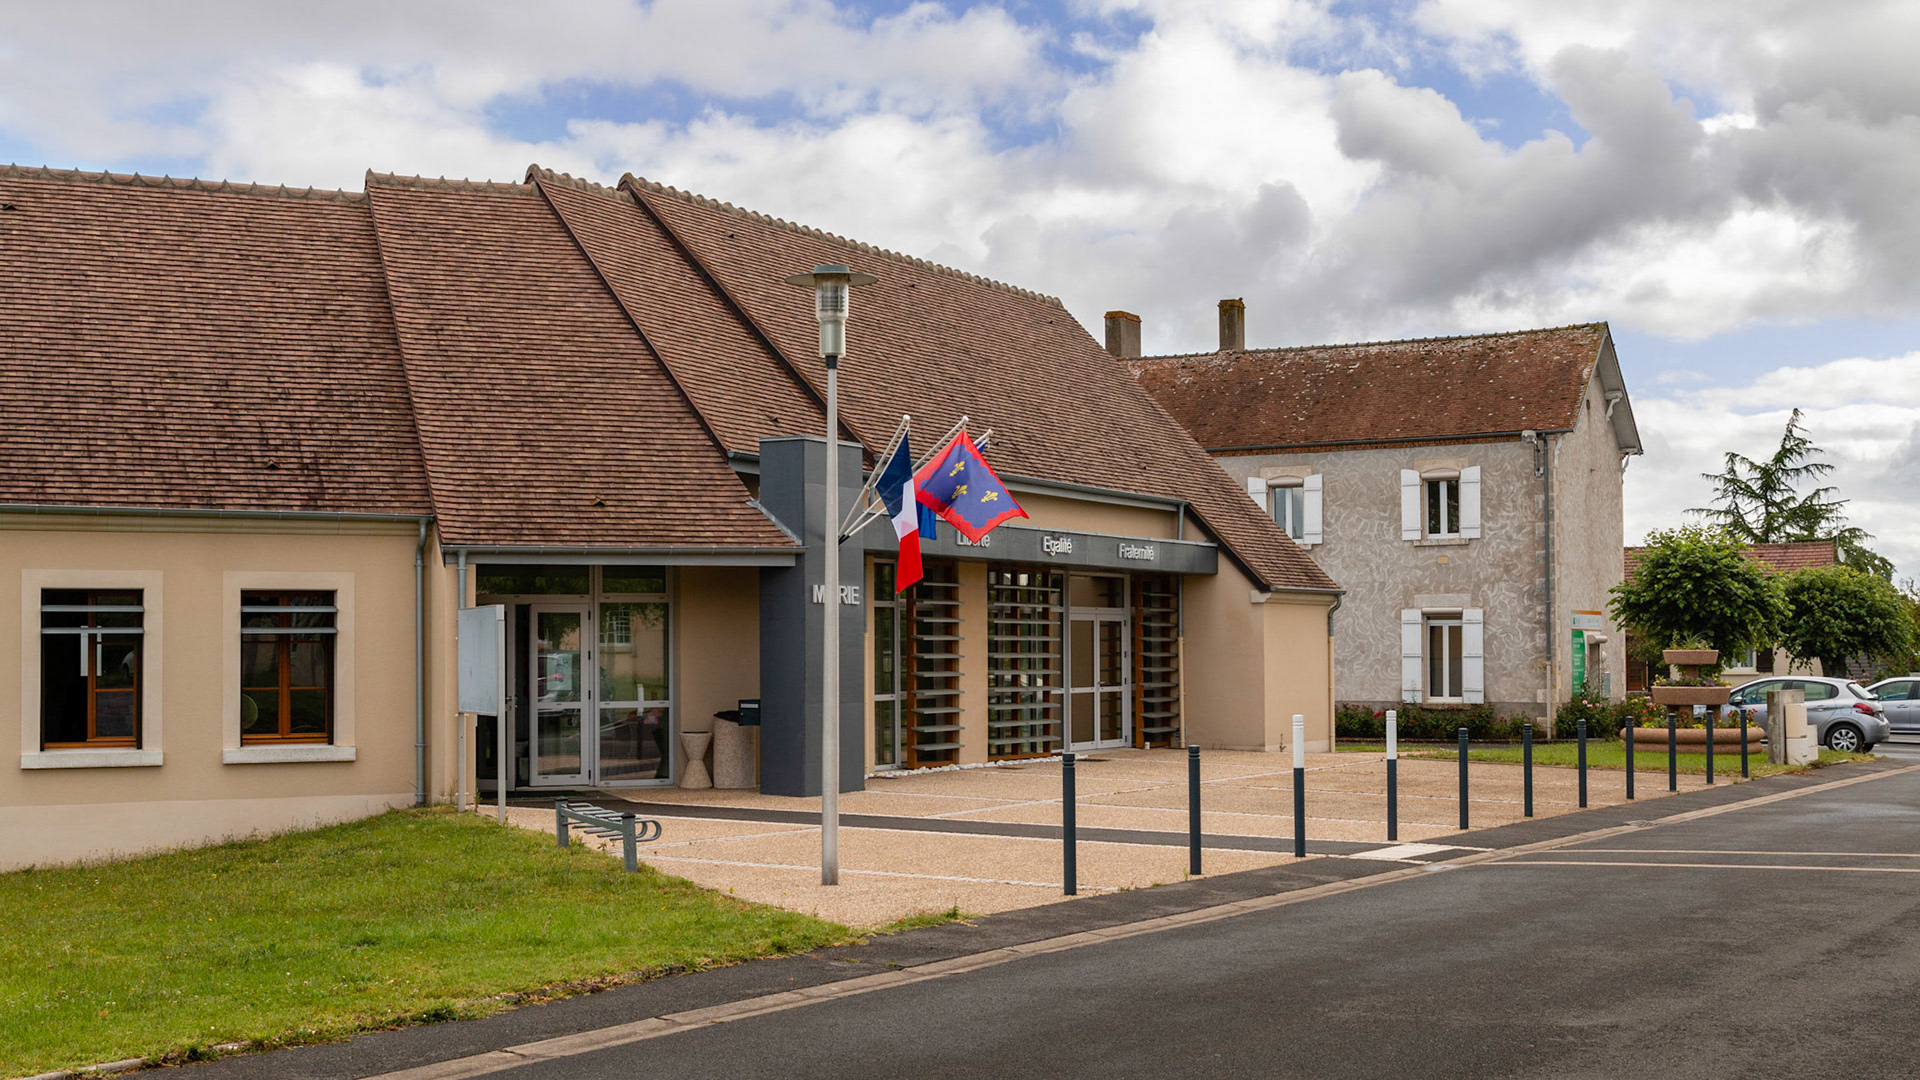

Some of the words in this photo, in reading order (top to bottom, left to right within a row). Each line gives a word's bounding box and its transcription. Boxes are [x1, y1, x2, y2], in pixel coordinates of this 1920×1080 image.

[1043, 536, 1072, 556] Egalité
[1119, 543, 1154, 560] Fraternité
[812, 584, 860, 605] MRIE
